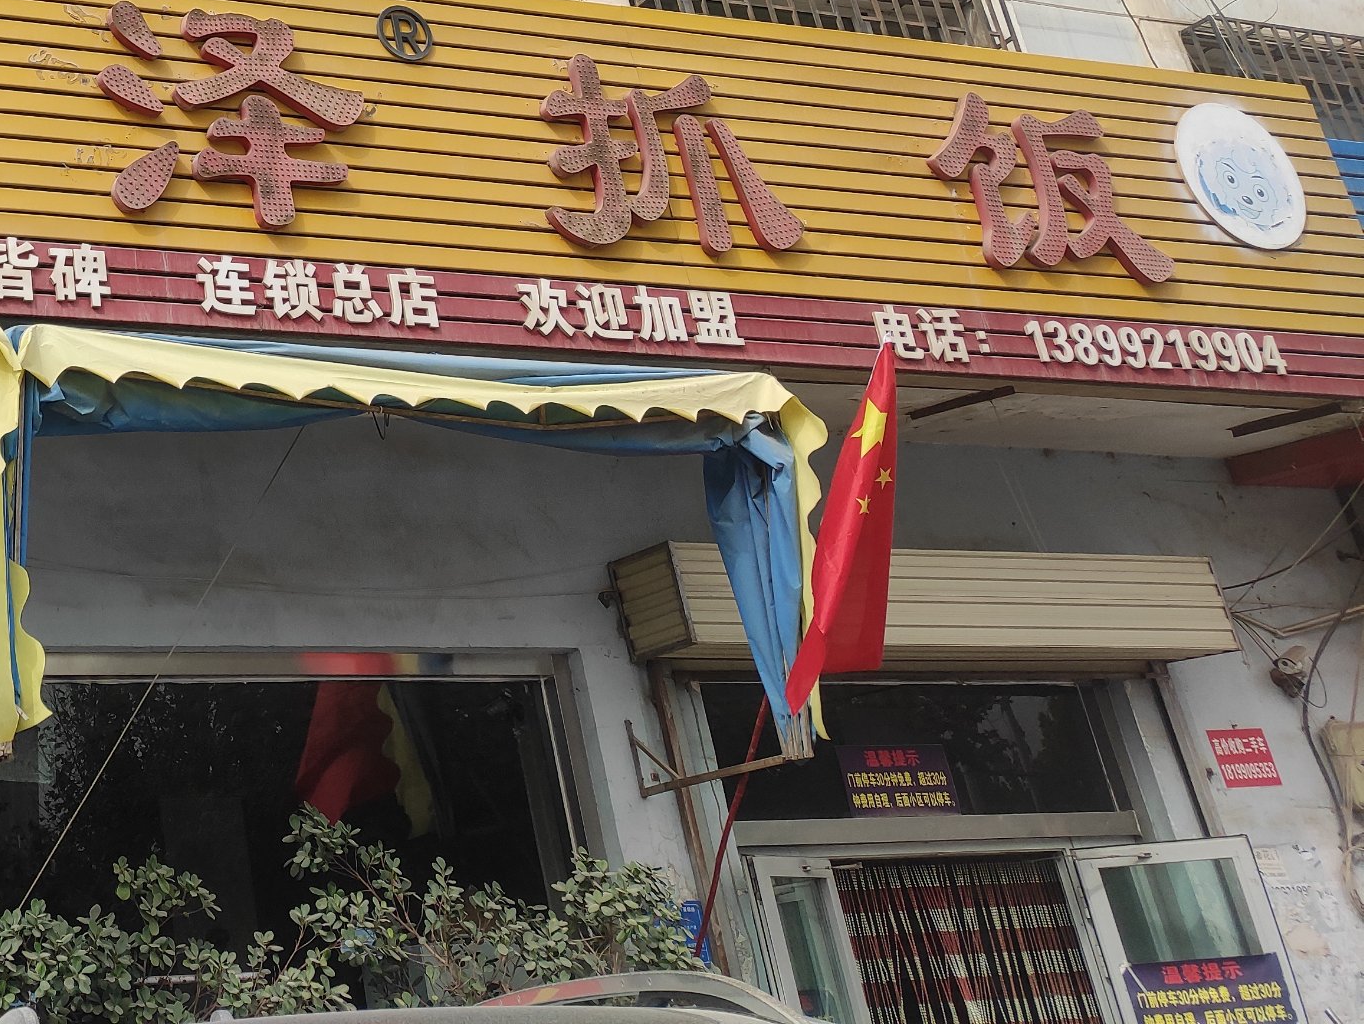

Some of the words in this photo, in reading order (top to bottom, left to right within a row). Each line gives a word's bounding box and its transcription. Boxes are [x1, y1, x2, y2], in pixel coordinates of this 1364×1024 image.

[196, 255, 440, 328] 连锁总店
[515, 278, 746, 346] 欢迎加盟
[1024, 320, 1289, 375] 13899219904
[1211, 737, 1267, 756] 高价收购二手车
[1161, 961, 1244, 985] 温馨提示
